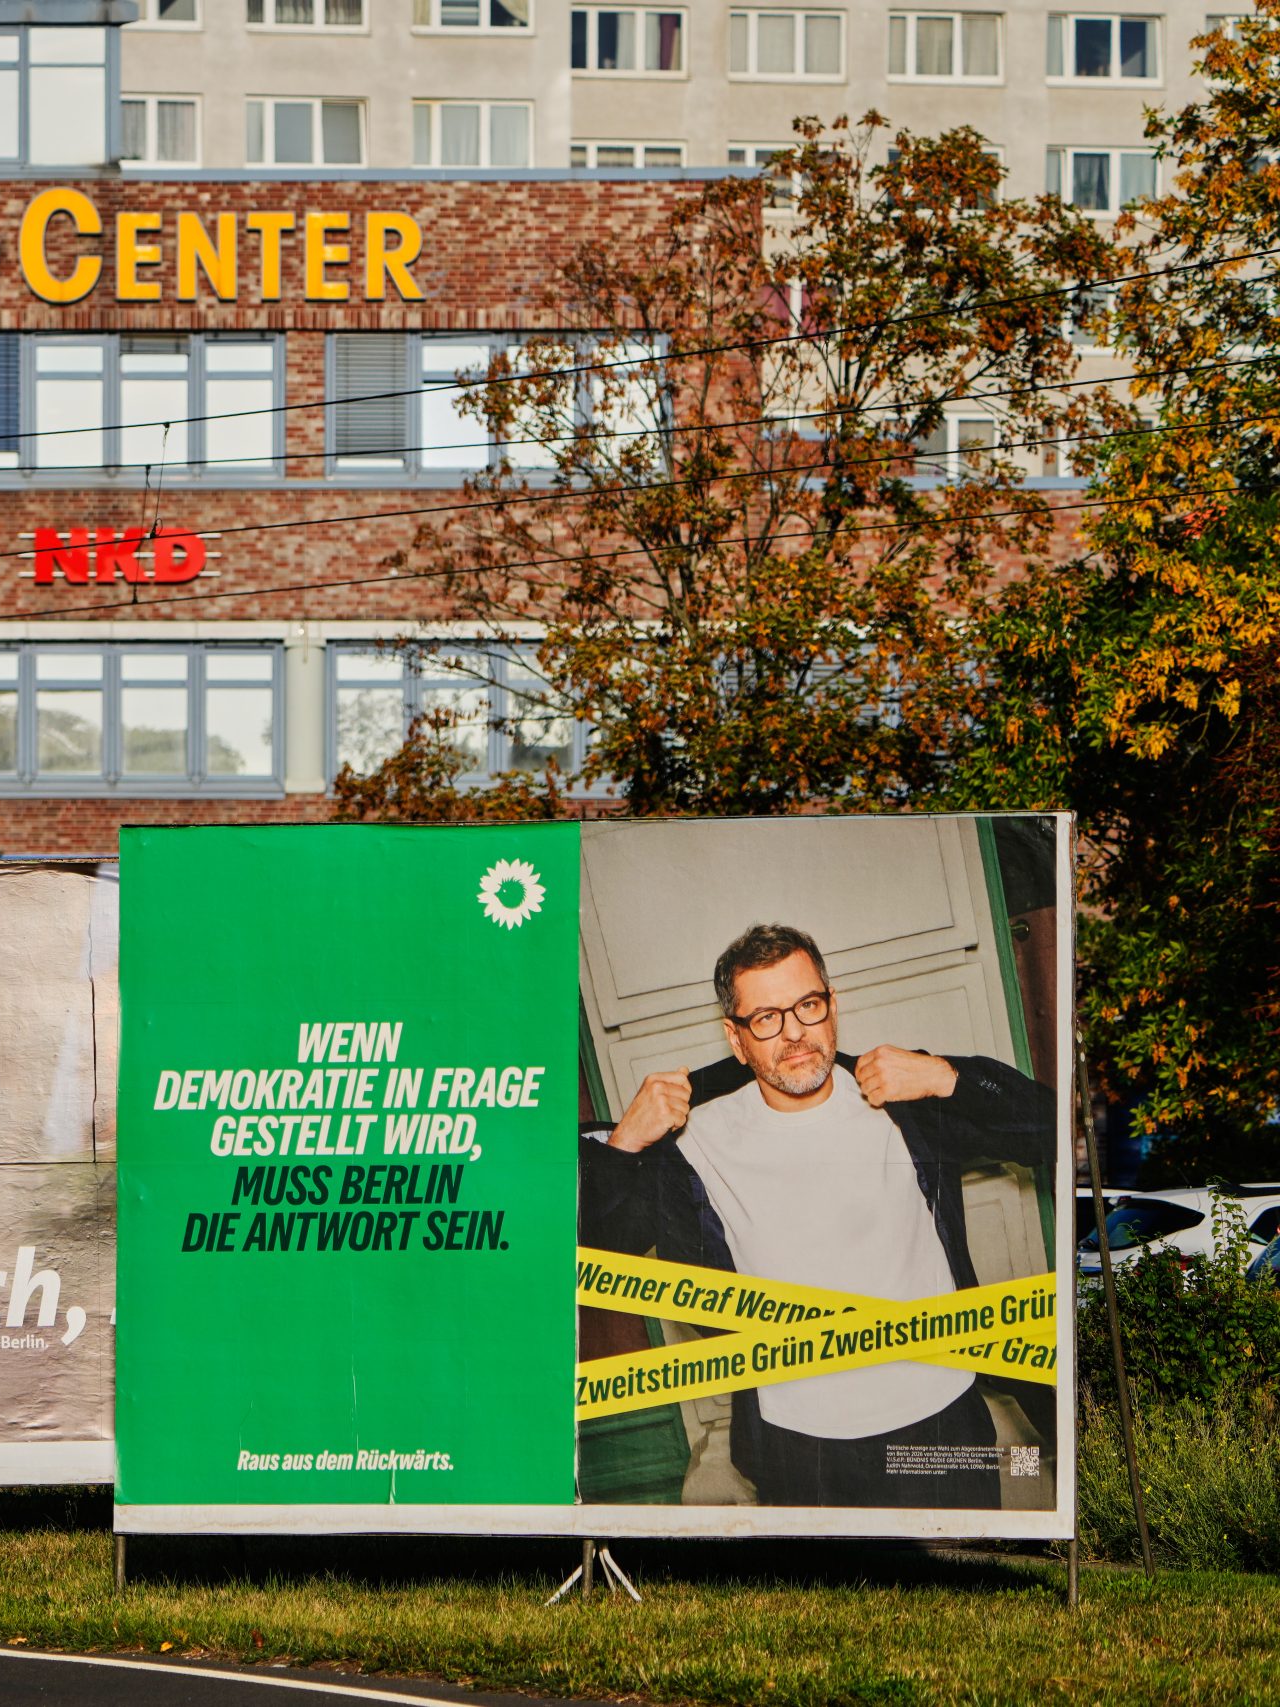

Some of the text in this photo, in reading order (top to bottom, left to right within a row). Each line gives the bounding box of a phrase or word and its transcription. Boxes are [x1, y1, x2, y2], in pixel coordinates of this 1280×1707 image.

[33, 526, 208, 585] NKD
[297, 1022, 404, 1063] WENN
[153, 1066, 546, 1111] DEMOKRATIE IN FRAGE
[210, 1113, 483, 1162] GESTELLT WIRD,
[230, 1163, 465, 1207] MUSS BERLIN
[180, 1209, 511, 1253] DIE ANTWORT SEIN.
[577, 1261, 836, 1325] Werner Graf Werne
[575, 1358, 746, 1407] Zweitstimme
[751, 1336, 814, 1372] Grün
[819, 1305, 995, 1361] Zweitstimme
[237, 1449, 455, 1472] Raus aus dem Rückwärts.
